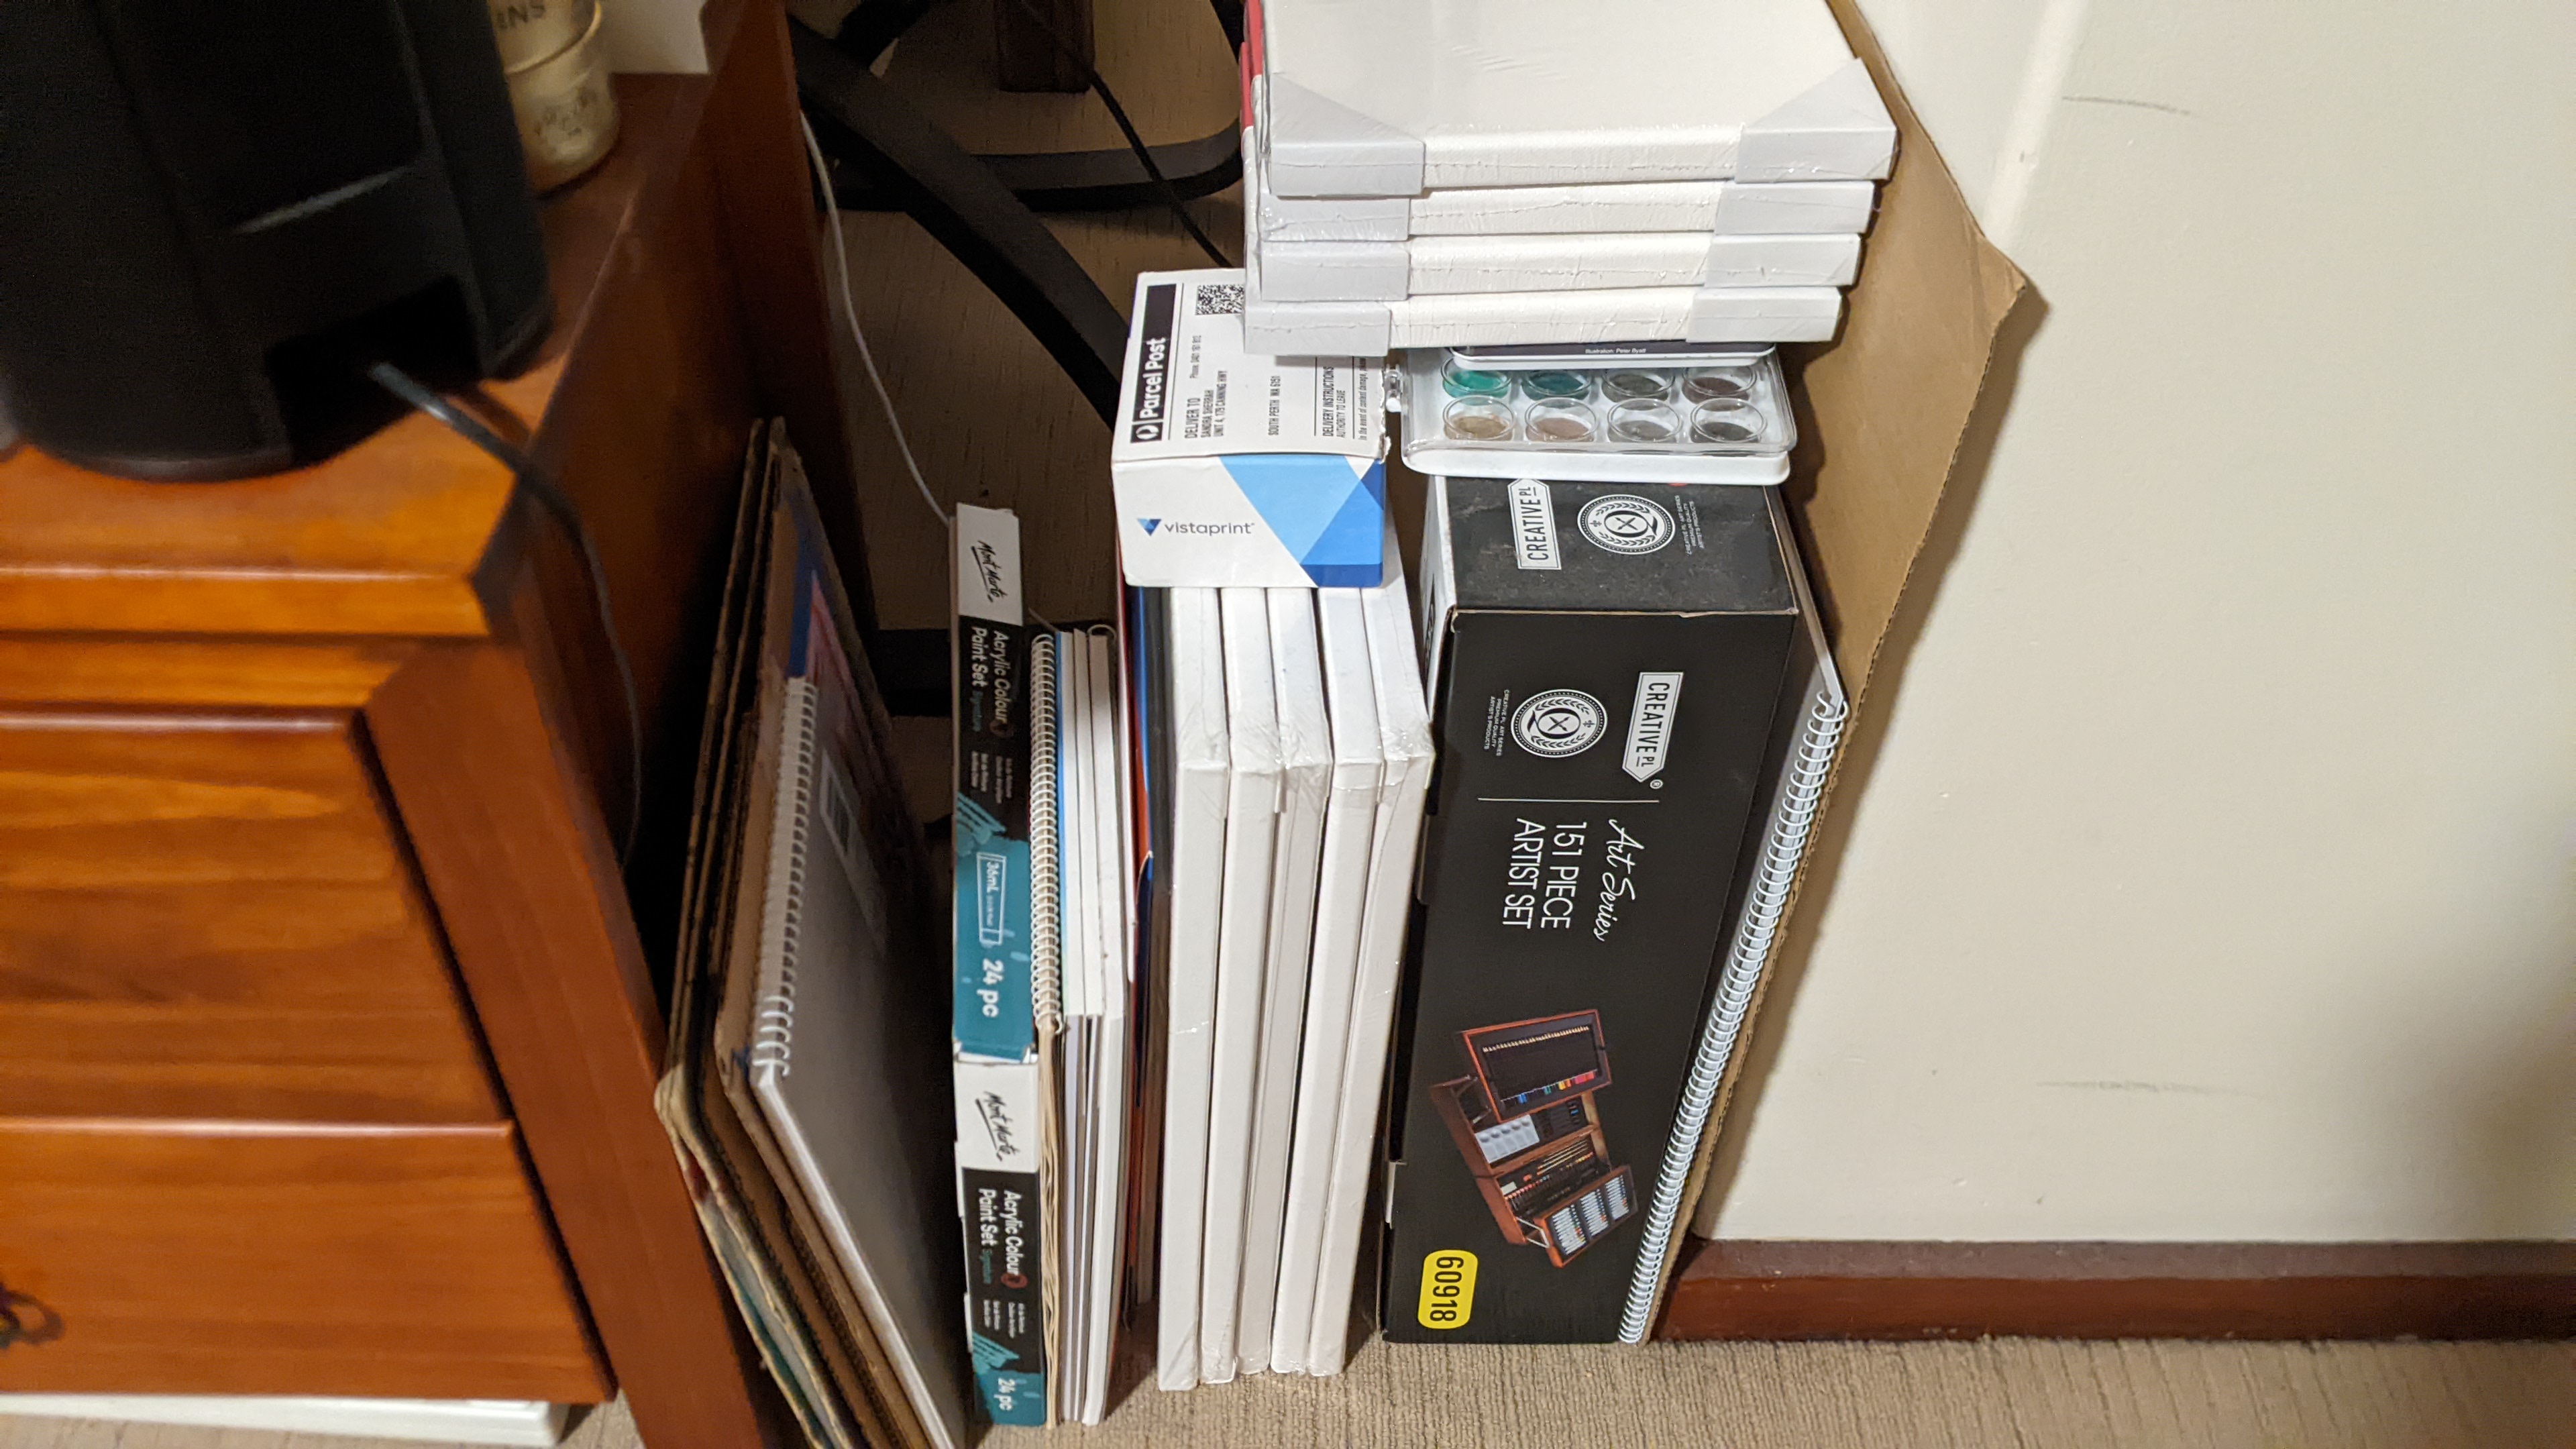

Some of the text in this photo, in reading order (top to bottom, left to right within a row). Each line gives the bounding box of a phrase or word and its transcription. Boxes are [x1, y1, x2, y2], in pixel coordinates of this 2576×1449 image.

[1139, 337, 1166, 419] Parcel Post
[1270, 388, 1280, 396] WA
[1269, 399, 1280, 417] PERTH
[1322, 366, 1334, 437] DELIVERY INSTRUCTIONS
[1336, 390, 1346, 404] LEAVE
[1185, 398, 1200, 439] DELIVER TO
[1268, 418, 1279, 436] SOUTH
[1336, 412, 1346, 438] AUTHORITY
[1358, 414, 1367, 426] event
[1164, 521, 1252, 536] vistaprint
[1519, 486, 1549, 561] CREATIVE PL
[971, 627, 988, 661] Paint
[971, 663, 989, 687] Set
[989, 631, 1013, 724] Acrylic Colour
[1635, 682, 1671, 767] CREATIVE PL
[1502, 818, 1546, 929] ARTIST SET
[1540, 822, 1587, 929] 151 PIECE
[1594, 818, 1645, 941] Art Series
[977, 959, 1004, 1018] 24 pc
[978, 1188, 998, 1222] Paint
[980, 1224, 998, 1246] Set
[1000, 1190, 1024, 1275] Acrylic Colour
[1430, 1256, 1464, 1322] 60918
[994, 1378, 1016, 1411] 24 pc
